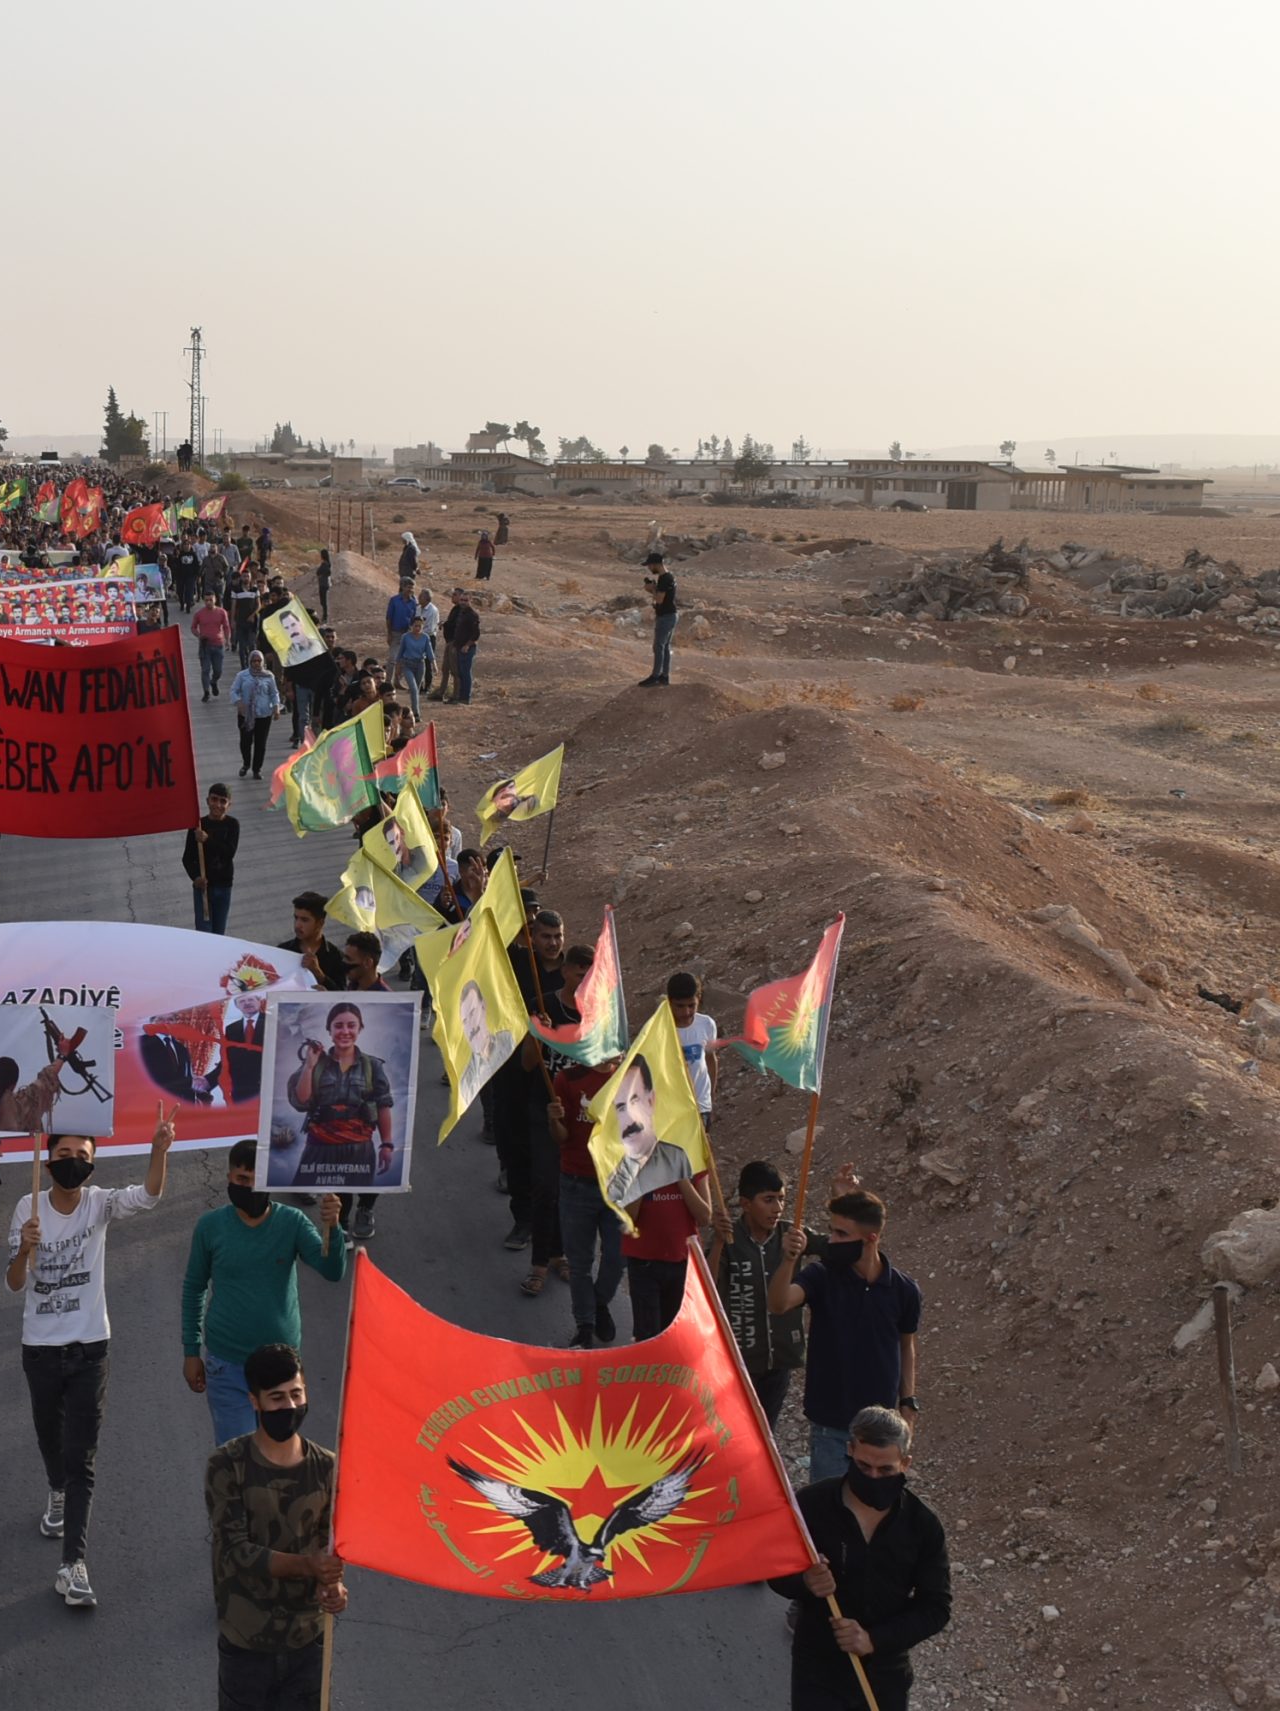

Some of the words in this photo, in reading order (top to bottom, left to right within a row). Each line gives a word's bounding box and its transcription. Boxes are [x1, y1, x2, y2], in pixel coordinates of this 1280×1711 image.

[15, 626, 52, 636] Armanca
[54, 628, 66, 636] we
[68, 625, 106, 635] Armanca
[107, 625, 130, 635] meye
[416, 1395, 477, 1453] TEVGERA
[470, 1367, 583, 1409] CIWANÊN
